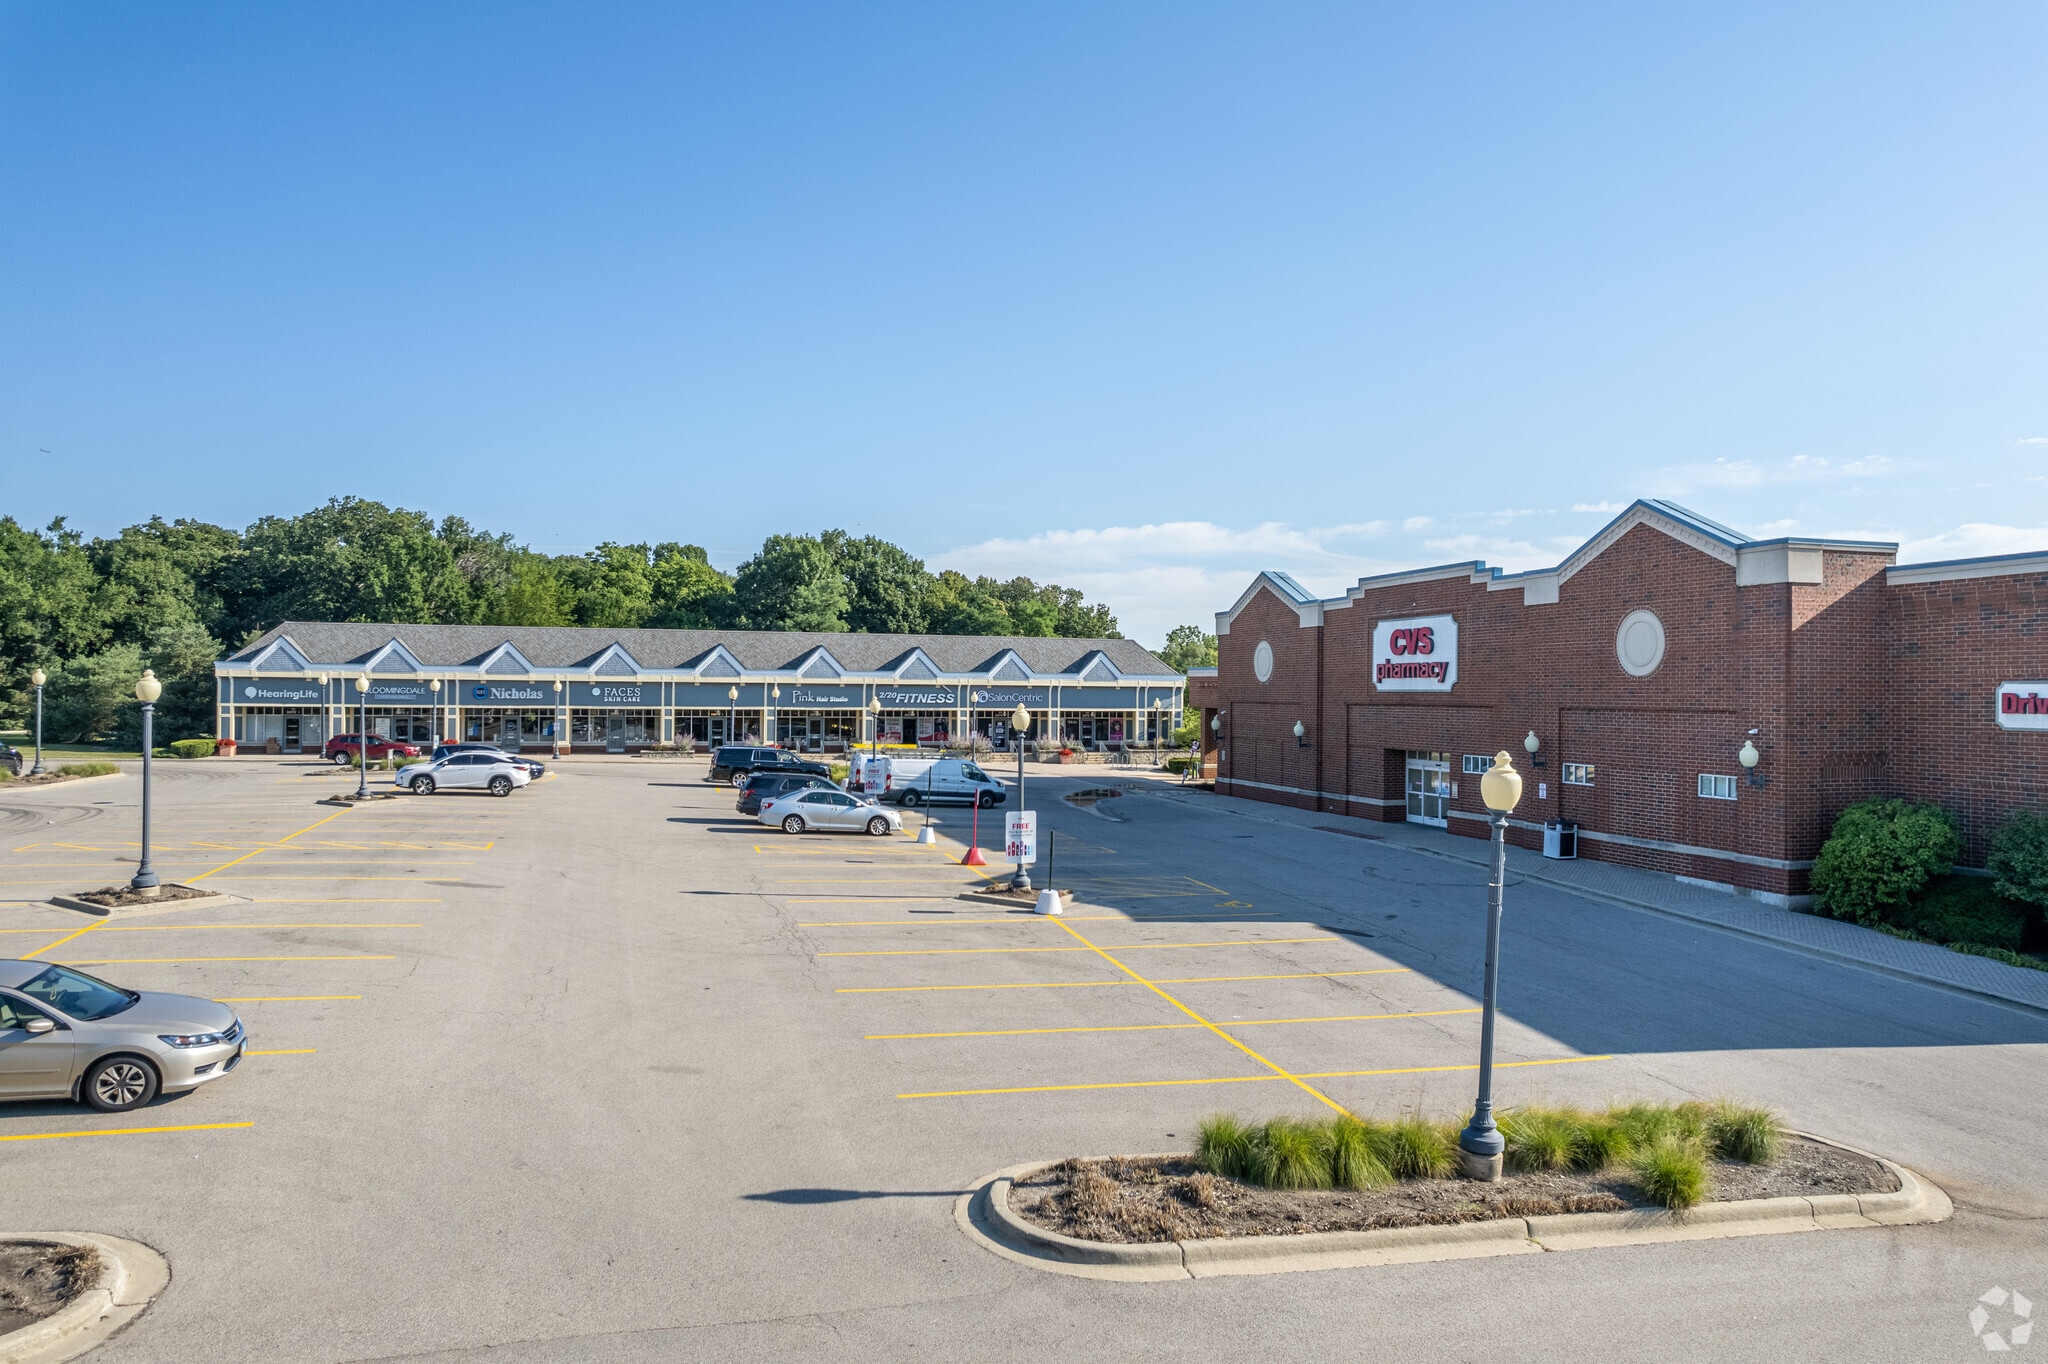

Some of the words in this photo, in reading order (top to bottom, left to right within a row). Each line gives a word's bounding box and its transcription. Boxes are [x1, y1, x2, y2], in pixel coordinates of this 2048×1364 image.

[1390, 627, 1434, 655] CVS
[1376, 659, 1449, 683] pharmacy
[258, 689, 319, 700] HearingLife
[490, 687, 543, 699] Nicholas
[604, 688, 641, 696] FACES
[792, 690, 814, 703] Pink
[988, 693, 1043, 702] SalonCentric
[896, 693, 955, 703] FITNESS
